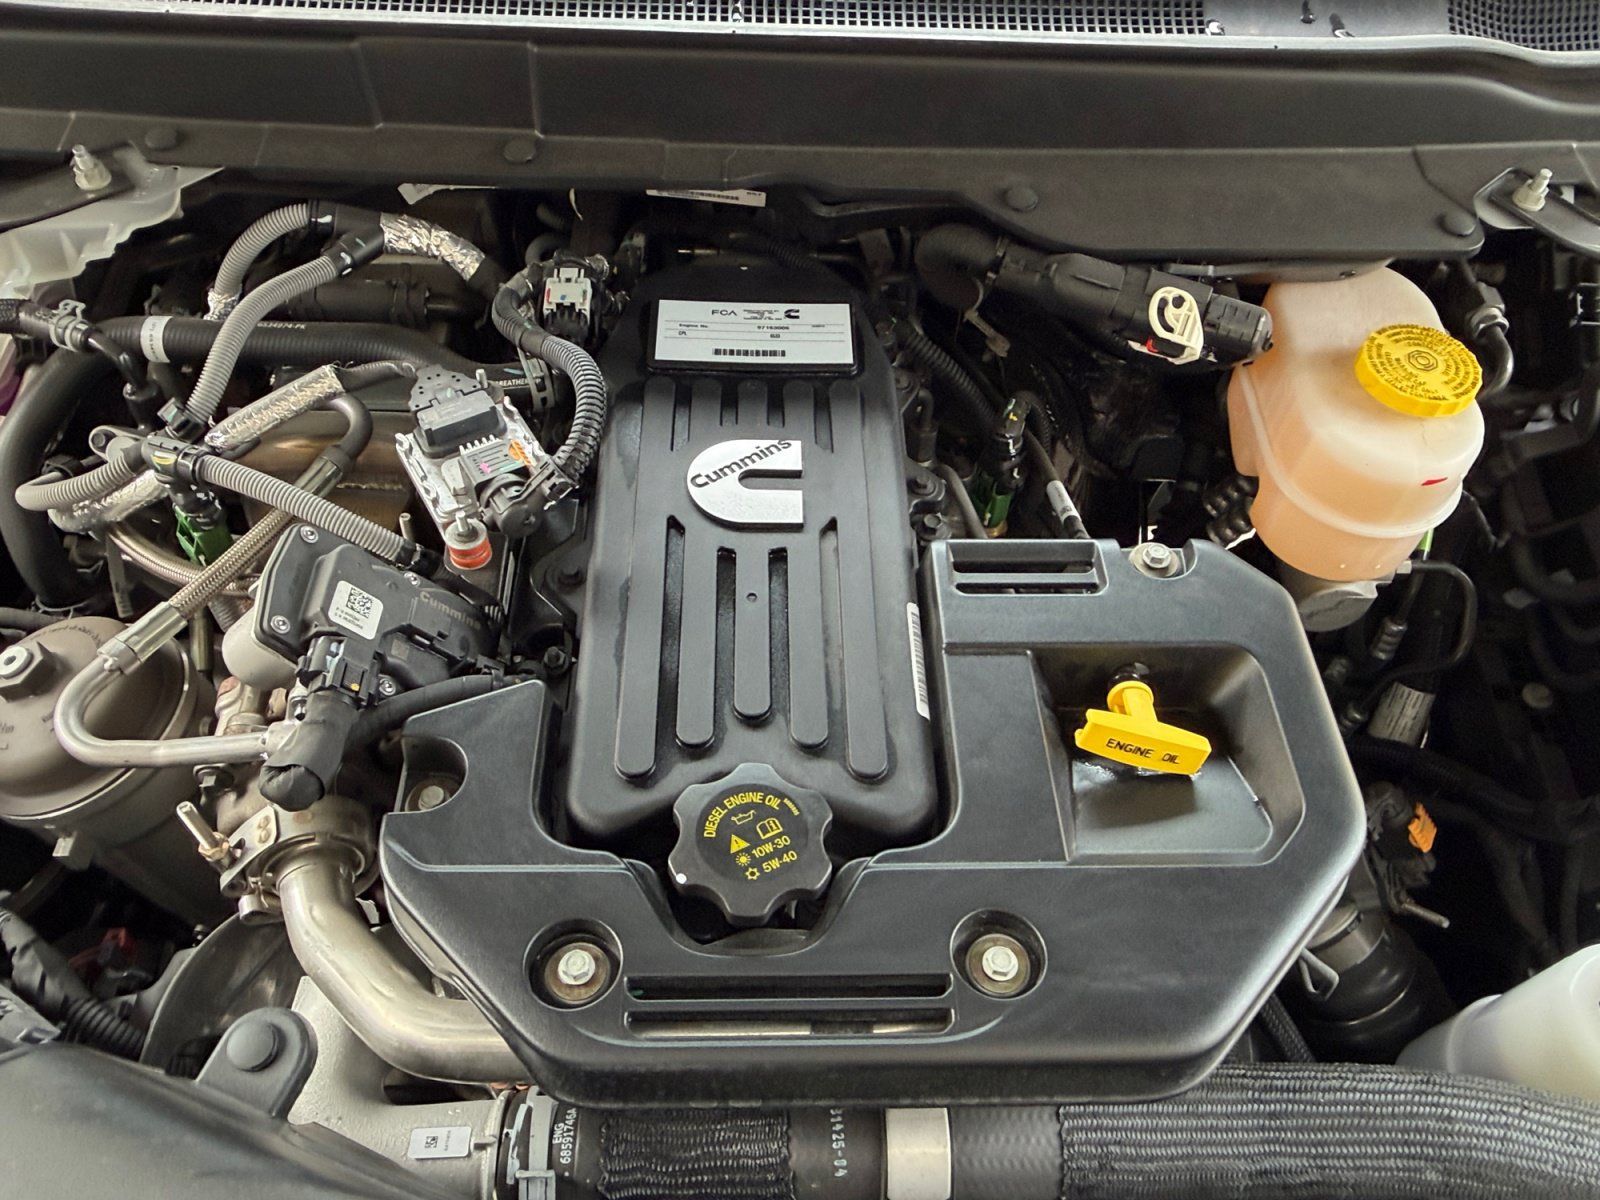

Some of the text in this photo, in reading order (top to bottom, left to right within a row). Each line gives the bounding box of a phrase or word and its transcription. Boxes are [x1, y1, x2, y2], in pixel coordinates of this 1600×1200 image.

[711, 309, 738, 317] FCA
[690, 439, 792, 488] Cummins
[419, 591, 481, 630] Cummins
[1105, 737, 1181, 764] ENGINE OIL
[703, 806, 728, 838] DIESEL
[723, 791, 764, 810] ENGINE
[764, 794, 782, 811] OIL
[751, 835, 791, 859] 10W-30
[762, 850, 798, 873] 5W-40
[552, 1122, 565, 1145] ENG
